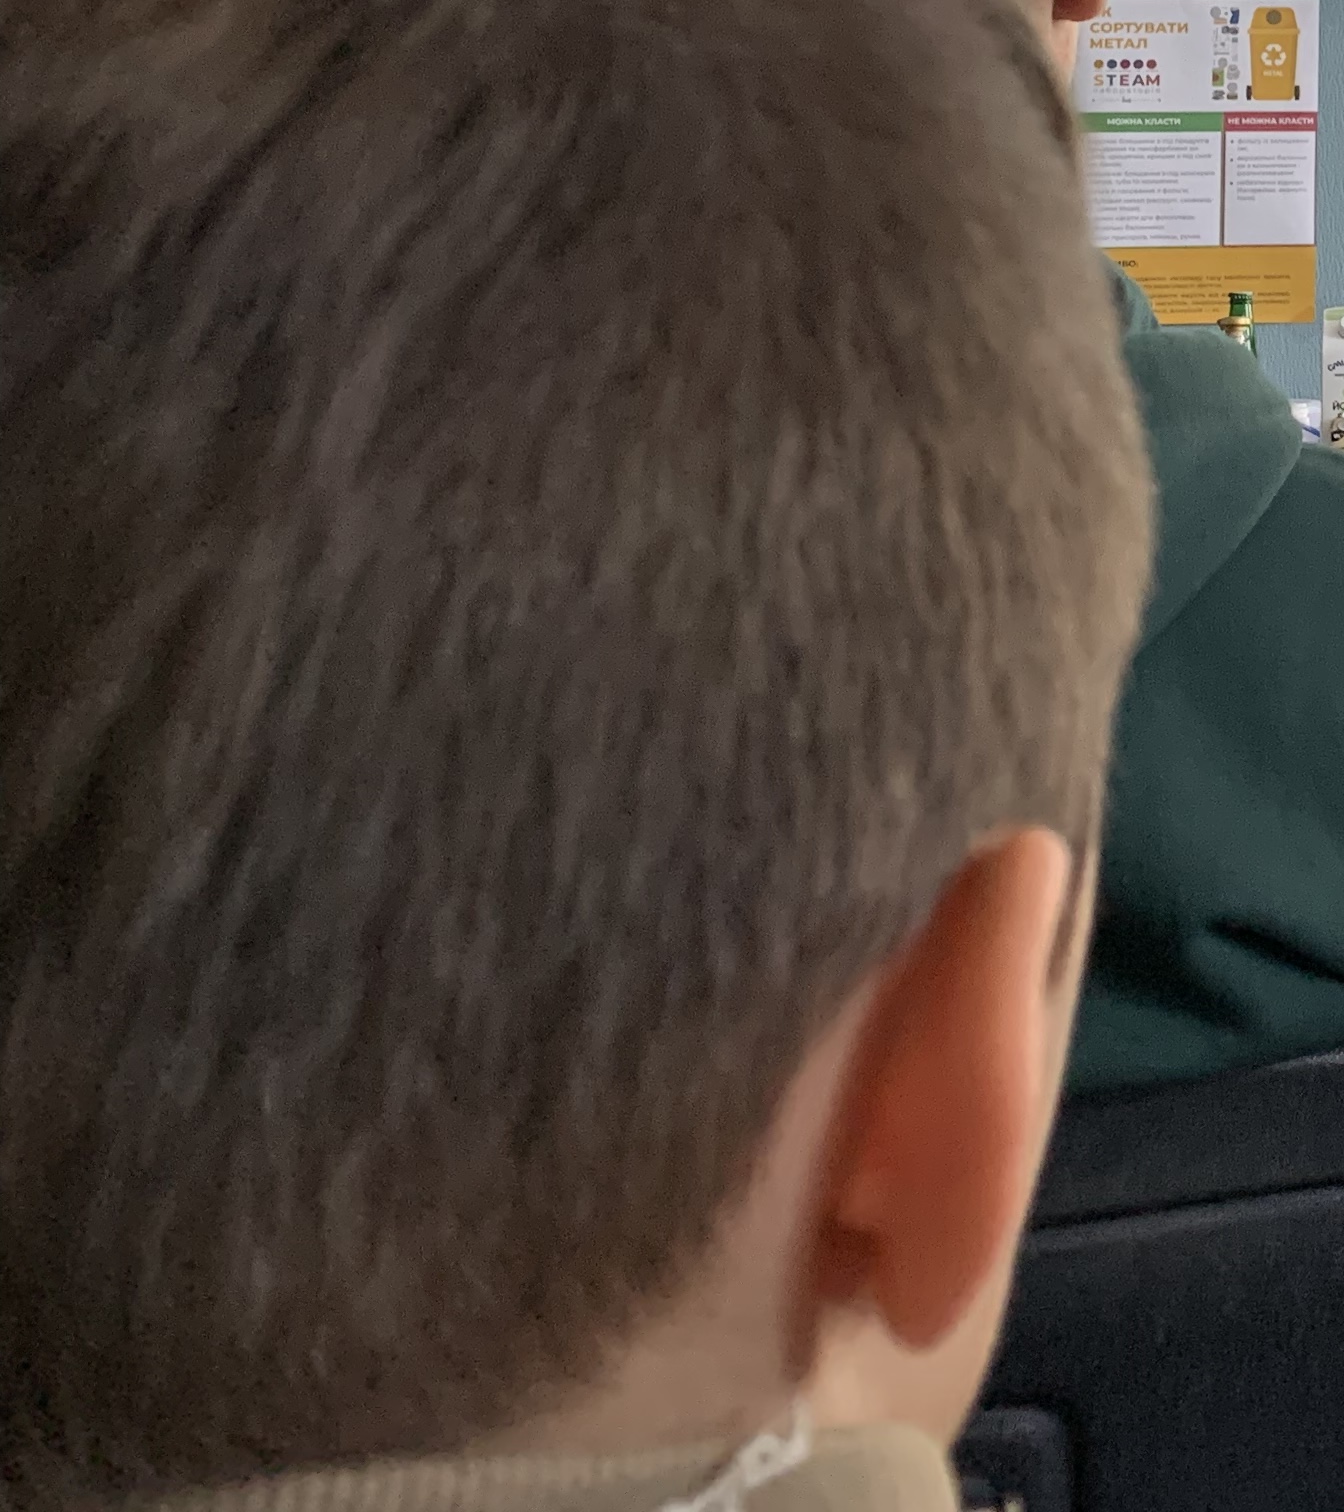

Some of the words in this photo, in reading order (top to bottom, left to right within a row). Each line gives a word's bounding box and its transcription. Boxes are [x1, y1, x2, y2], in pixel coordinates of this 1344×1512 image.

[1090, 22, 1188, 33] СОРТУВАТИ
[1090, 38, 1148, 49] МЕТАЛ
[1094, 74, 1160, 86] STEAM
